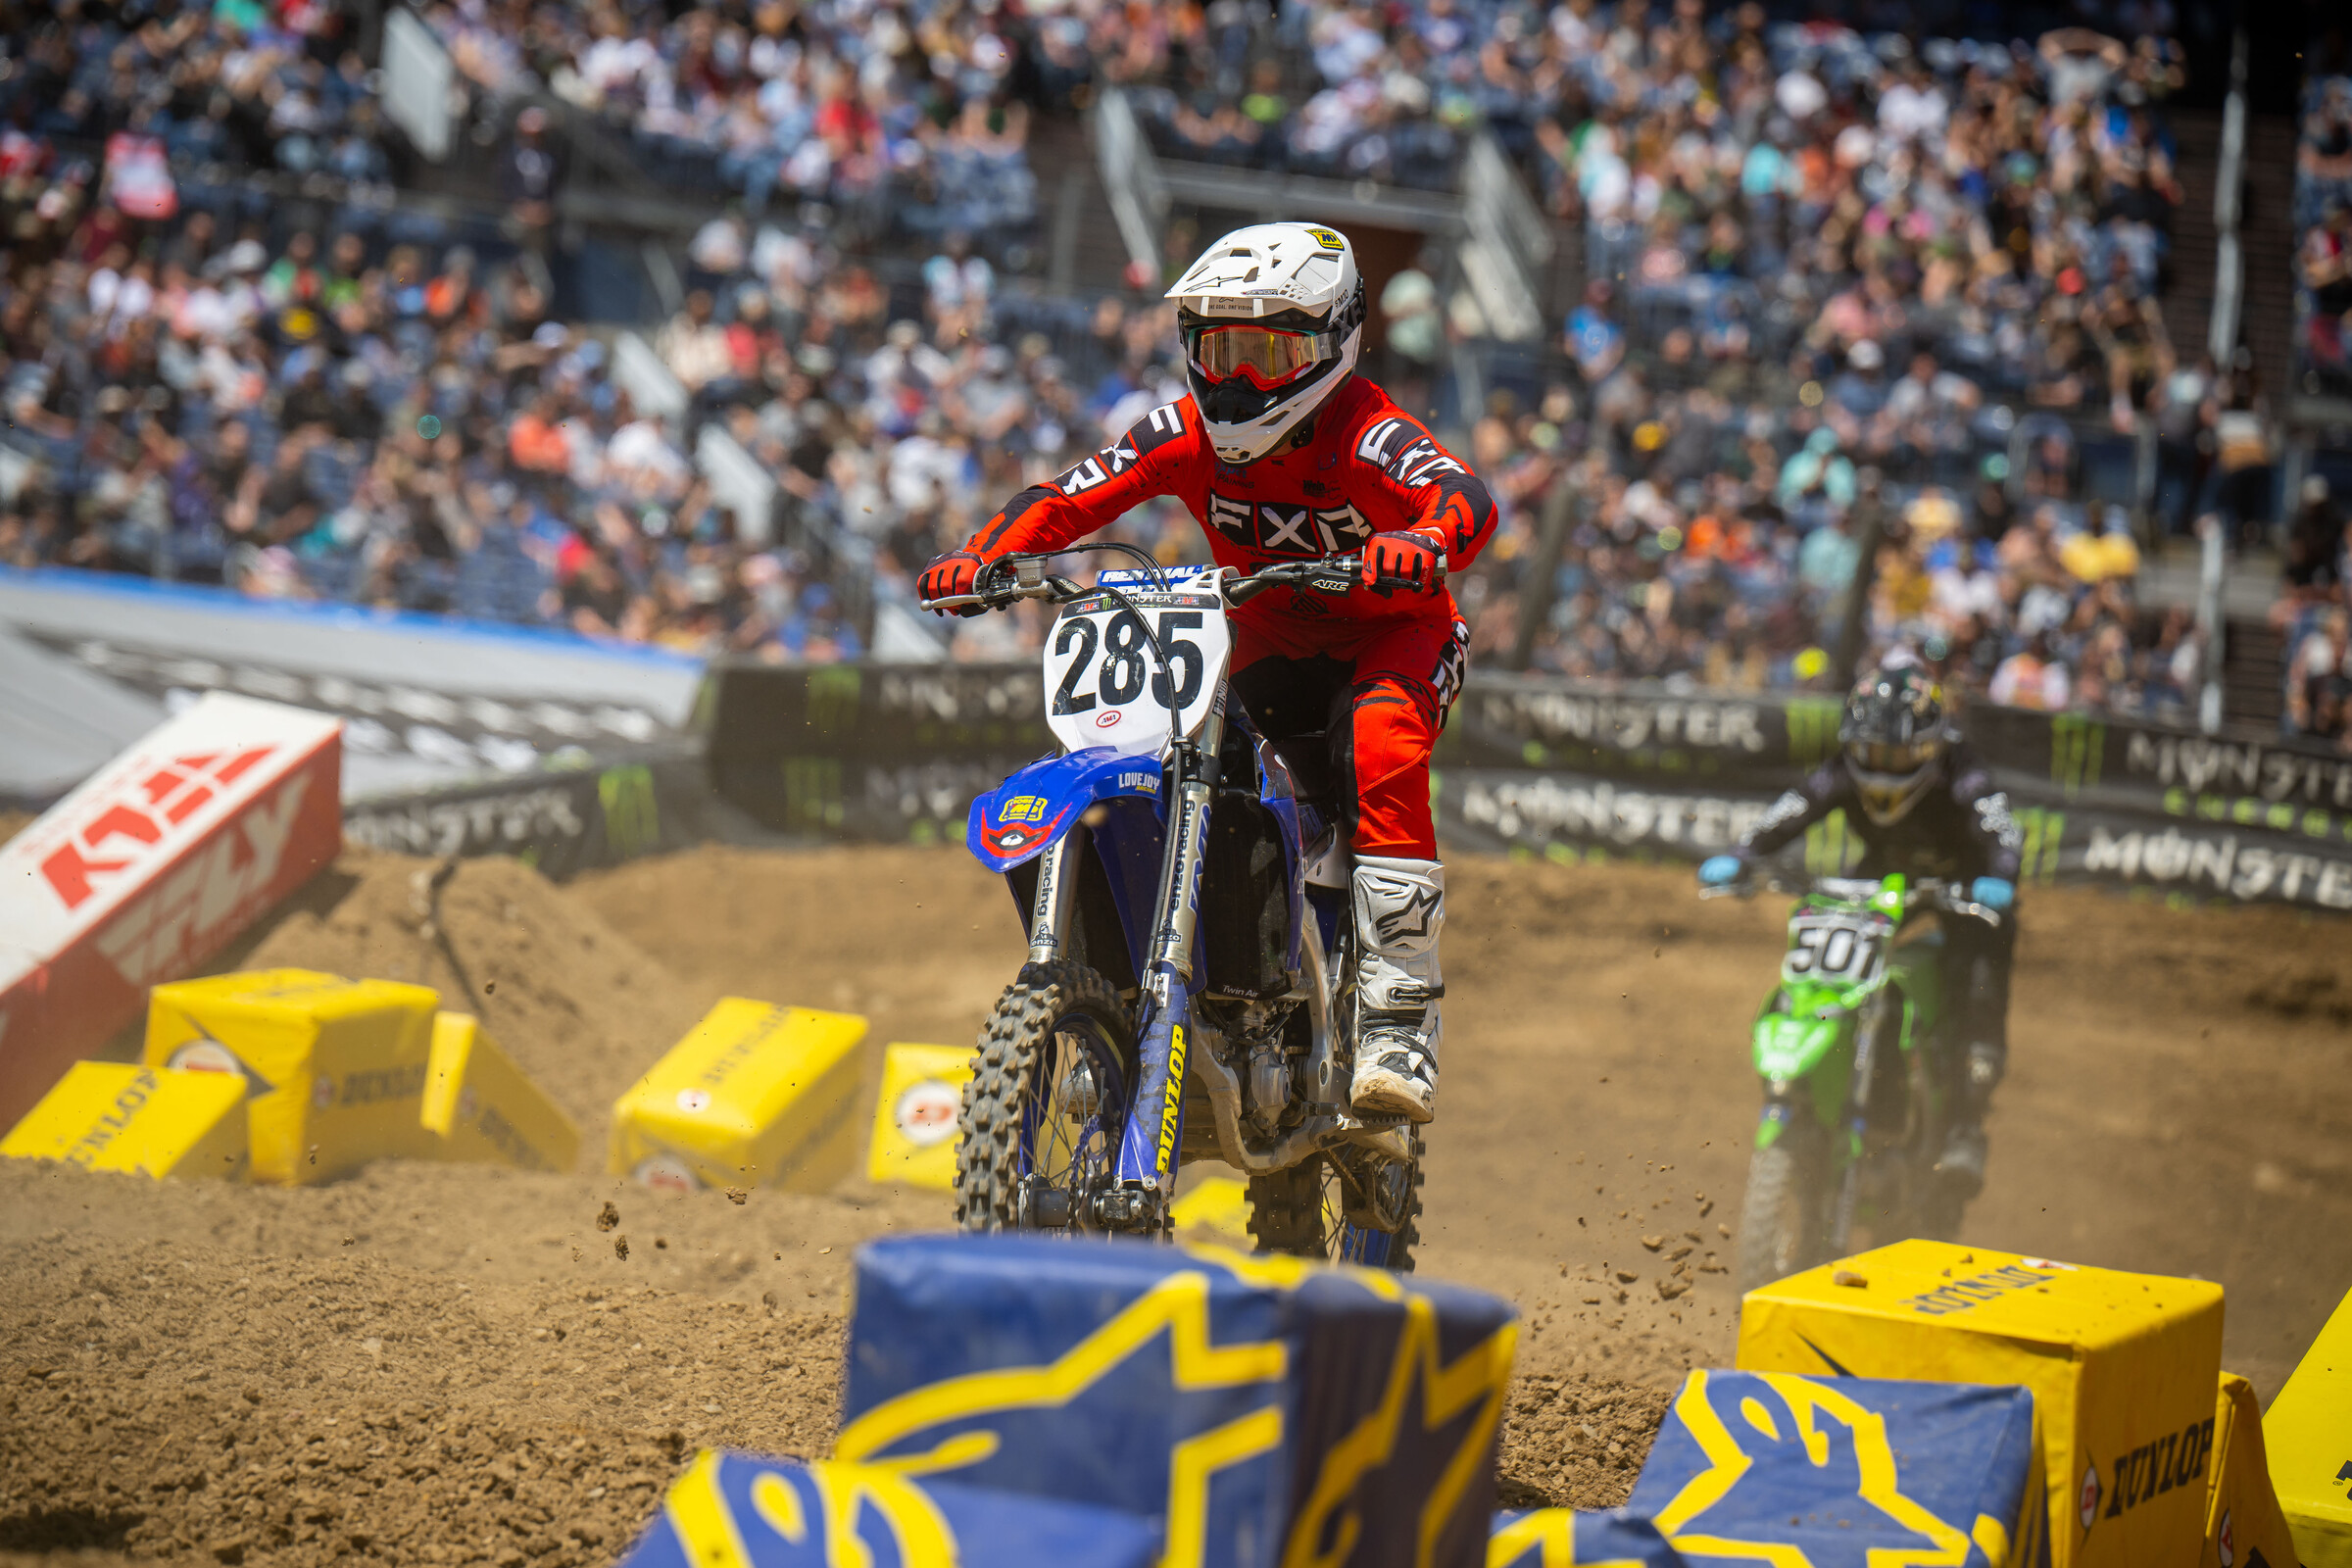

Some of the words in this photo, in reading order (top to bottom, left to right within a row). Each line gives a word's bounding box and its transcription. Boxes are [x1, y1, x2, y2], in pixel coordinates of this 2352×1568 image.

[1209, 493, 1372, 553] FXR
[1312, 579, 1349, 591] ARC
[1053, 609, 1203, 715] 285
[1118, 772, 1160, 790] LOVEJOY
[1031, 938, 1058, 948] enzo
[1223, 985, 1245, 996] Twin
[1156, 1024, 1188, 1175] DUNLOP
[2104, 1416, 2215, 1519] DUNLOP
